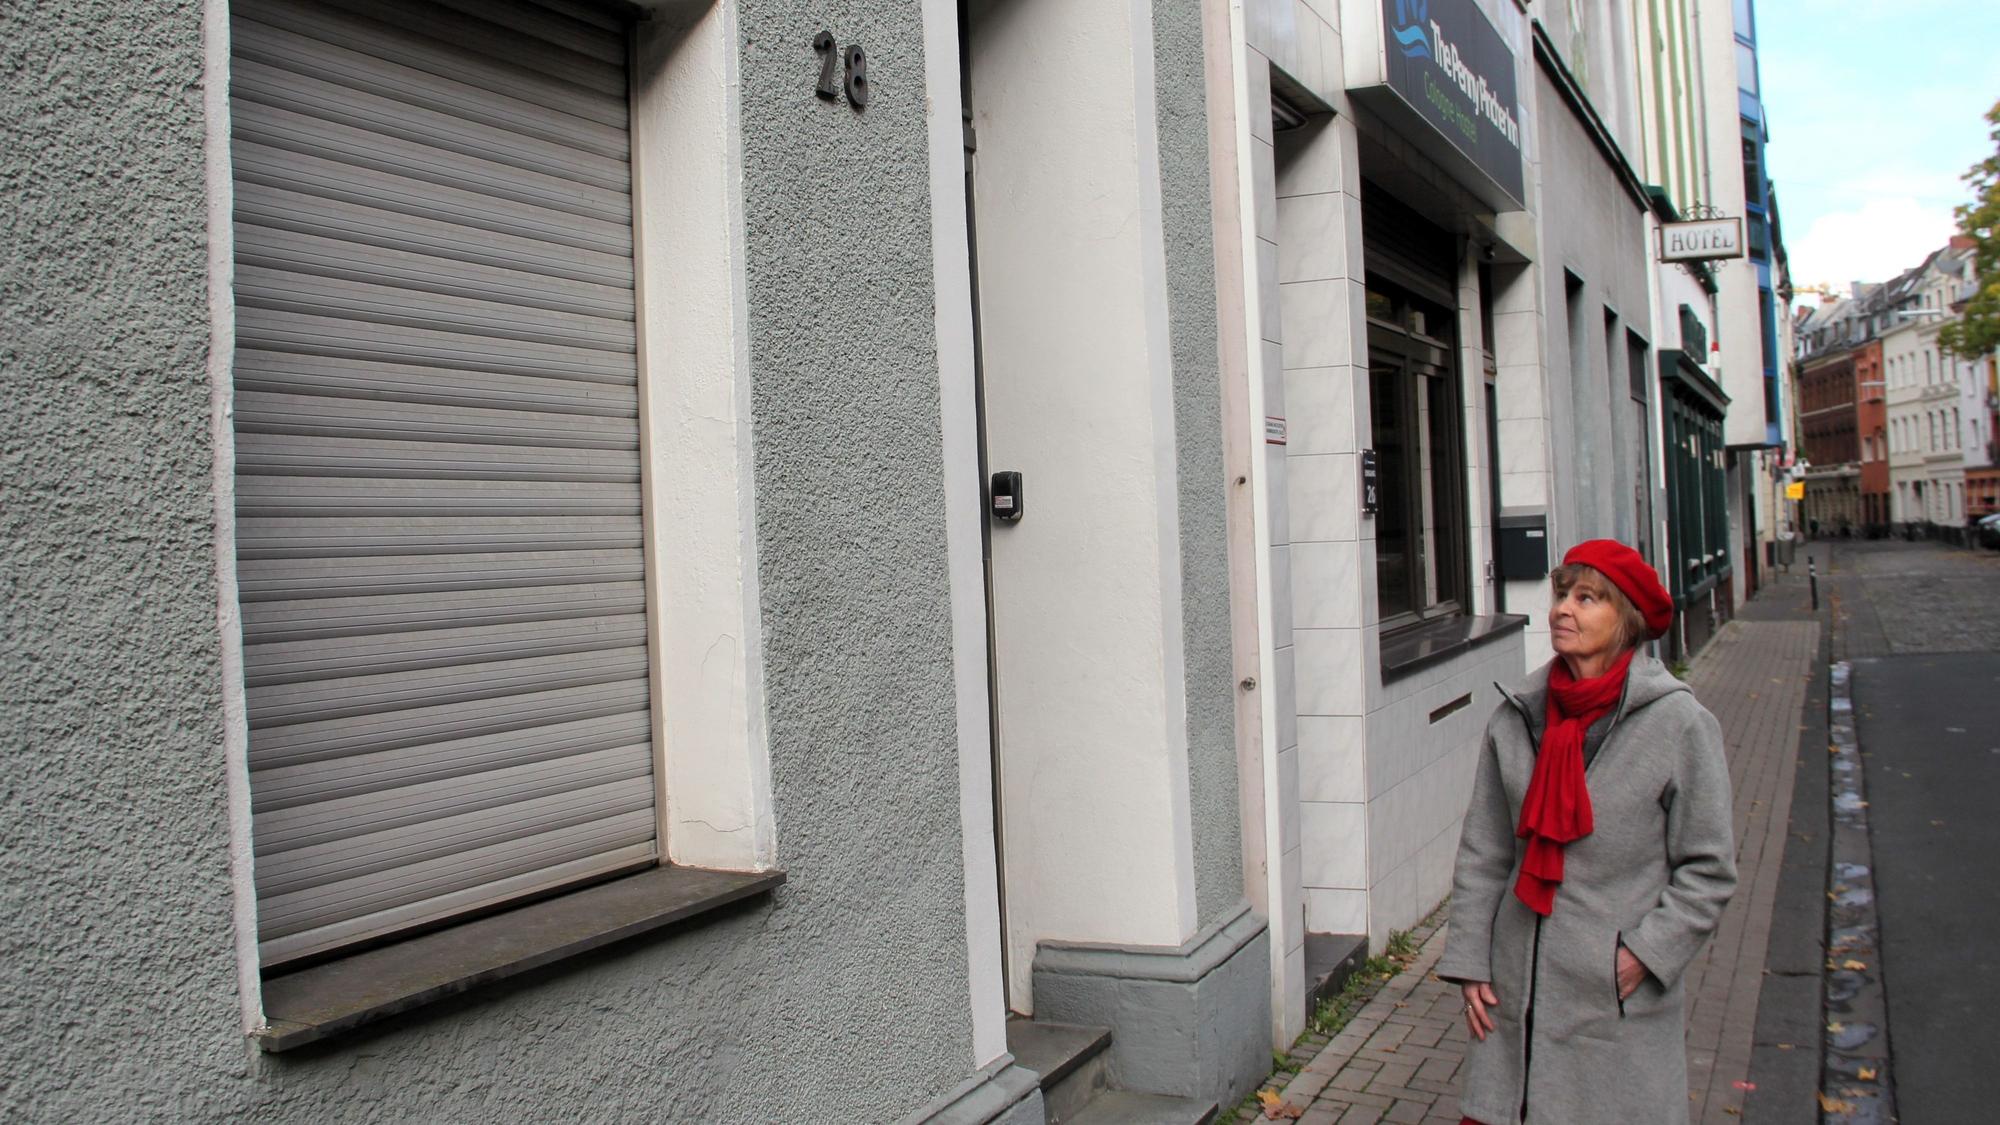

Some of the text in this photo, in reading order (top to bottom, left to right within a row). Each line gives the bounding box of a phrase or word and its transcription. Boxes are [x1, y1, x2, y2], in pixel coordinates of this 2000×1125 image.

[813, 30, 868, 111] 28
[1671, 228, 1734, 252] HOTEL
[1367, 485, 1376, 504] 26
